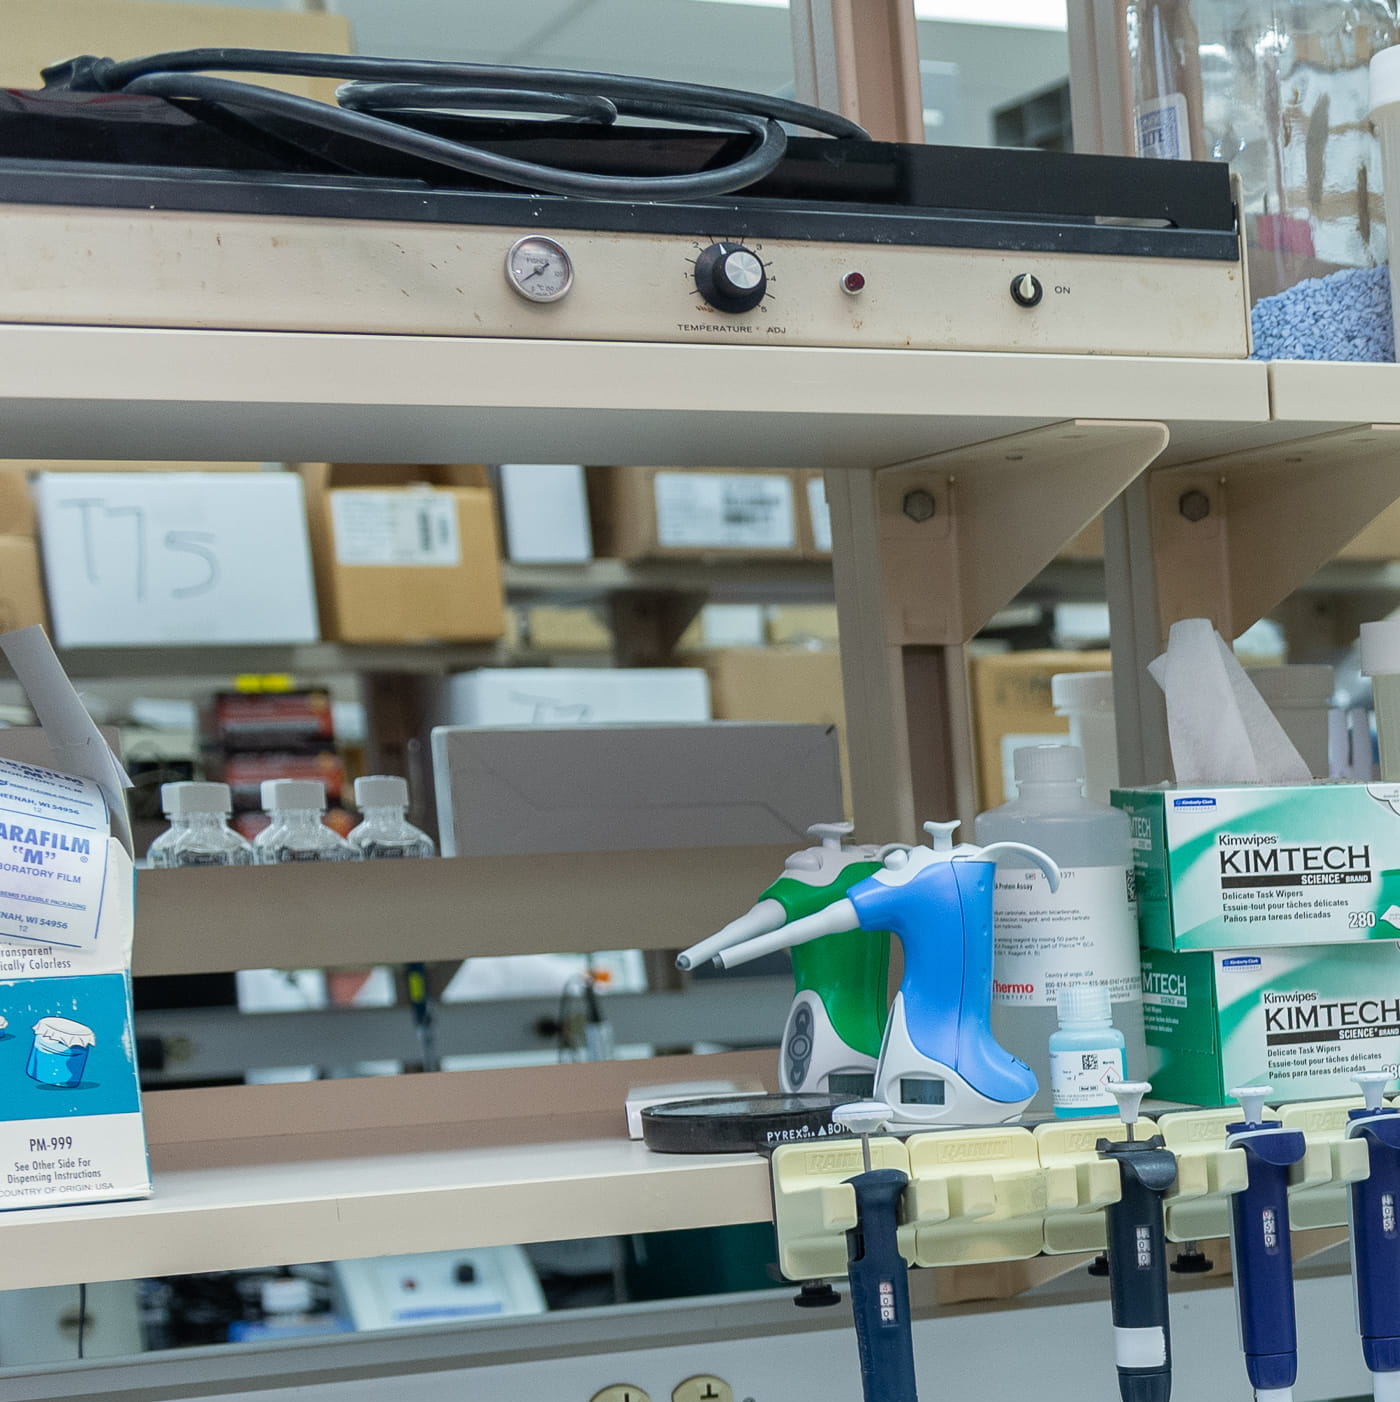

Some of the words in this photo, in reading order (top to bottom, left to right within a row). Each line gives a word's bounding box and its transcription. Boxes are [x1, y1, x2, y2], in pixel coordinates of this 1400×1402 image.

[1054, 285, 1071, 295] ON
[677, 324, 753, 333] TEMPERATURE
[766, 326, 786, 334] ADJ
[1220, 845, 1370, 874] KIMTECH
[57, 872, 81, 884] FILM
[1345, 875, 1369, 883] BRAND
[1222, 891, 1254, 900] Delicate
[1257, 890, 1274, 899] Task
[1276, 890, 1303, 899] Wipers
[1223, 903, 1267, 912] Essuie-tout
[1268, 904, 1283, 912] pour
[26, 916, 38, 925] WI
[39, 918, 68, 929] 54956
[1223, 912, 1247, 922] Paños
[1249, 914, 1268, 922] para
[1269, 912, 1292, 920] tareas
[1294, 910, 1331, 920] delicadas
[1349, 911, 1376, 928] 280
[30, 957, 71, 969] Colorless
[1265, 998, 1400, 1031] KIMTECH
[1268, 1048, 1297, 1057] Delicate
[1299, 1046, 1315, 1055] Task
[1315, 1044, 1341, 1054] Wipers
[1268, 1058, 1306, 1068] Essuie-tout
[1308, 1058, 1323, 1067] pour
[1292, 1070, 1308, 1078] para
[1309, 1067, 1330, 1076] tareas
[1332, 1064, 1366, 1074] delicadas
[767, 1128, 802, 1141] PYREX
[30, 1136, 72, 1152] PM-999
[15, 1162, 29, 1171] See
[33, 1160, 54, 1170] Other
[58, 1158, 75, 1168] Side
[78, 1158, 91, 1167] For
[7, 1173, 51, 1184] Dispensing
[55, 1169, 101, 1180] Instructions
